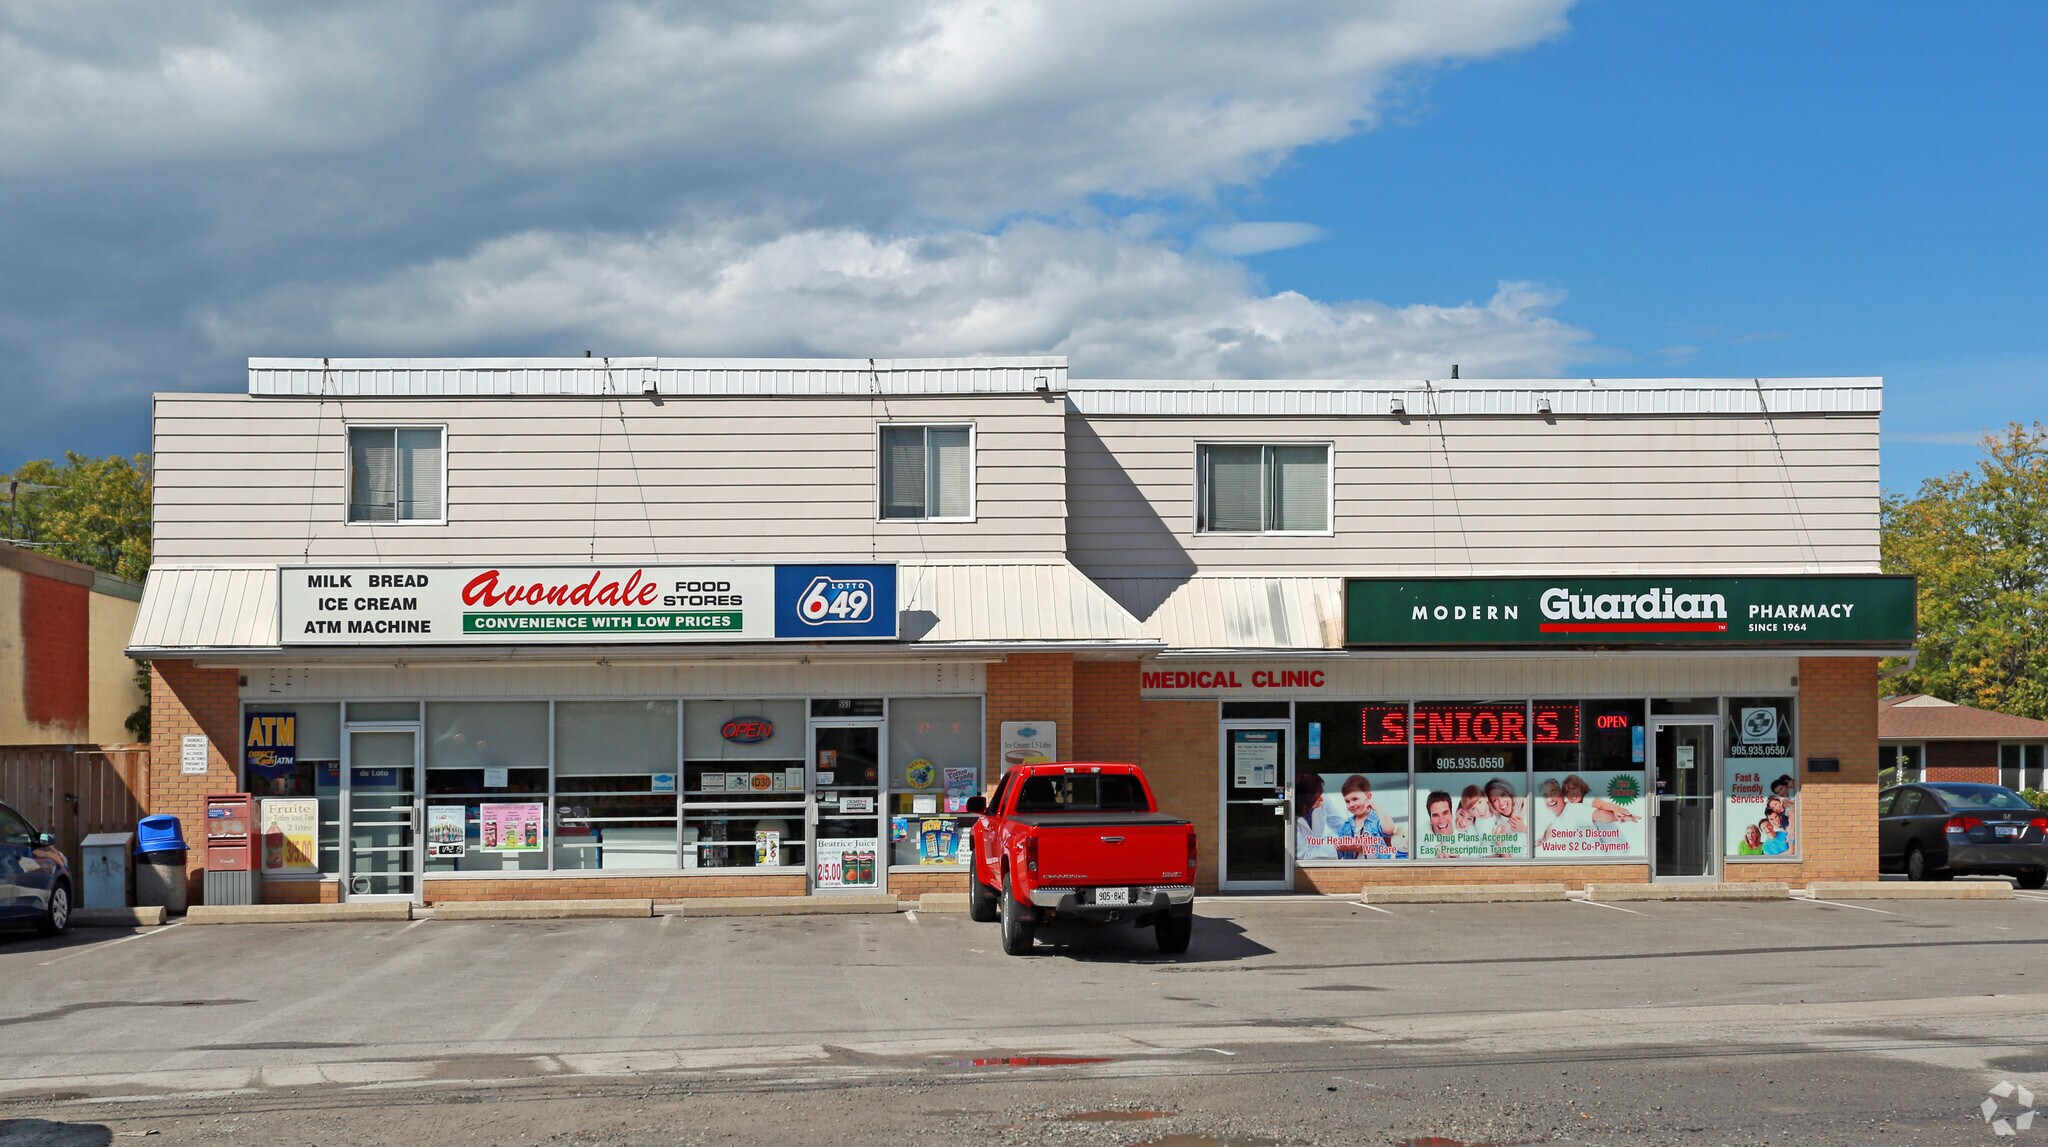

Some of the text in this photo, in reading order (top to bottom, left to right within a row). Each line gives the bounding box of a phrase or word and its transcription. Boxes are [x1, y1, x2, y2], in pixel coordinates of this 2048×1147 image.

[308, 575, 429, 587] MILK BREAD
[462, 569, 658, 607] Avondale
[675, 582, 731, 592] FOOD
[318, 598, 417, 610] ICE CREAM
[663, 595, 743, 606] STORES
[1540, 588, 1727, 620] Guardian
[1412, 606, 1518, 620] MODERN
[1749, 604, 1854, 618] PHARMACY
[304, 620, 431, 633] ATM MACHINE
[475, 616, 731, 628] CONVENIENCE WITH LOW PRICES
[1748, 623, 1807, 632] SINCE 1964
[1142, 670, 1325, 689] MEDICAL CLINIC
[1597, 715, 1628, 729] OPEN
[247, 717, 295, 747] ATM
[722, 722, 773, 738] OPEN
[1731, 746, 1785, 755] 905.935.0550
[276, 757, 293, 765] ATM
[1437, 757, 1504, 769] 905.935.0550
[359, 769, 389, 777] de Loto
[1735, 773, 1760, 782] Fast &
[1732, 784, 1763, 794] Friendly
[1731, 795, 1764, 803] Services
[269, 804, 311, 814] Fruite
[1424, 833, 1518, 844] All Drug Plans Accepted
[1551, 829, 1619, 838] Senior's Discount
[818, 840, 876, 848] Beatrice Juice
[1307, 836, 1324, 845] Your
[1327, 836, 1353, 845] Health
[1362, 845, 1397, 854] We Care
[1420, 845, 1522, 856] Easy Prescription Transfer
[1542, 842, 1629, 852] Waive $2 Co-Payment
